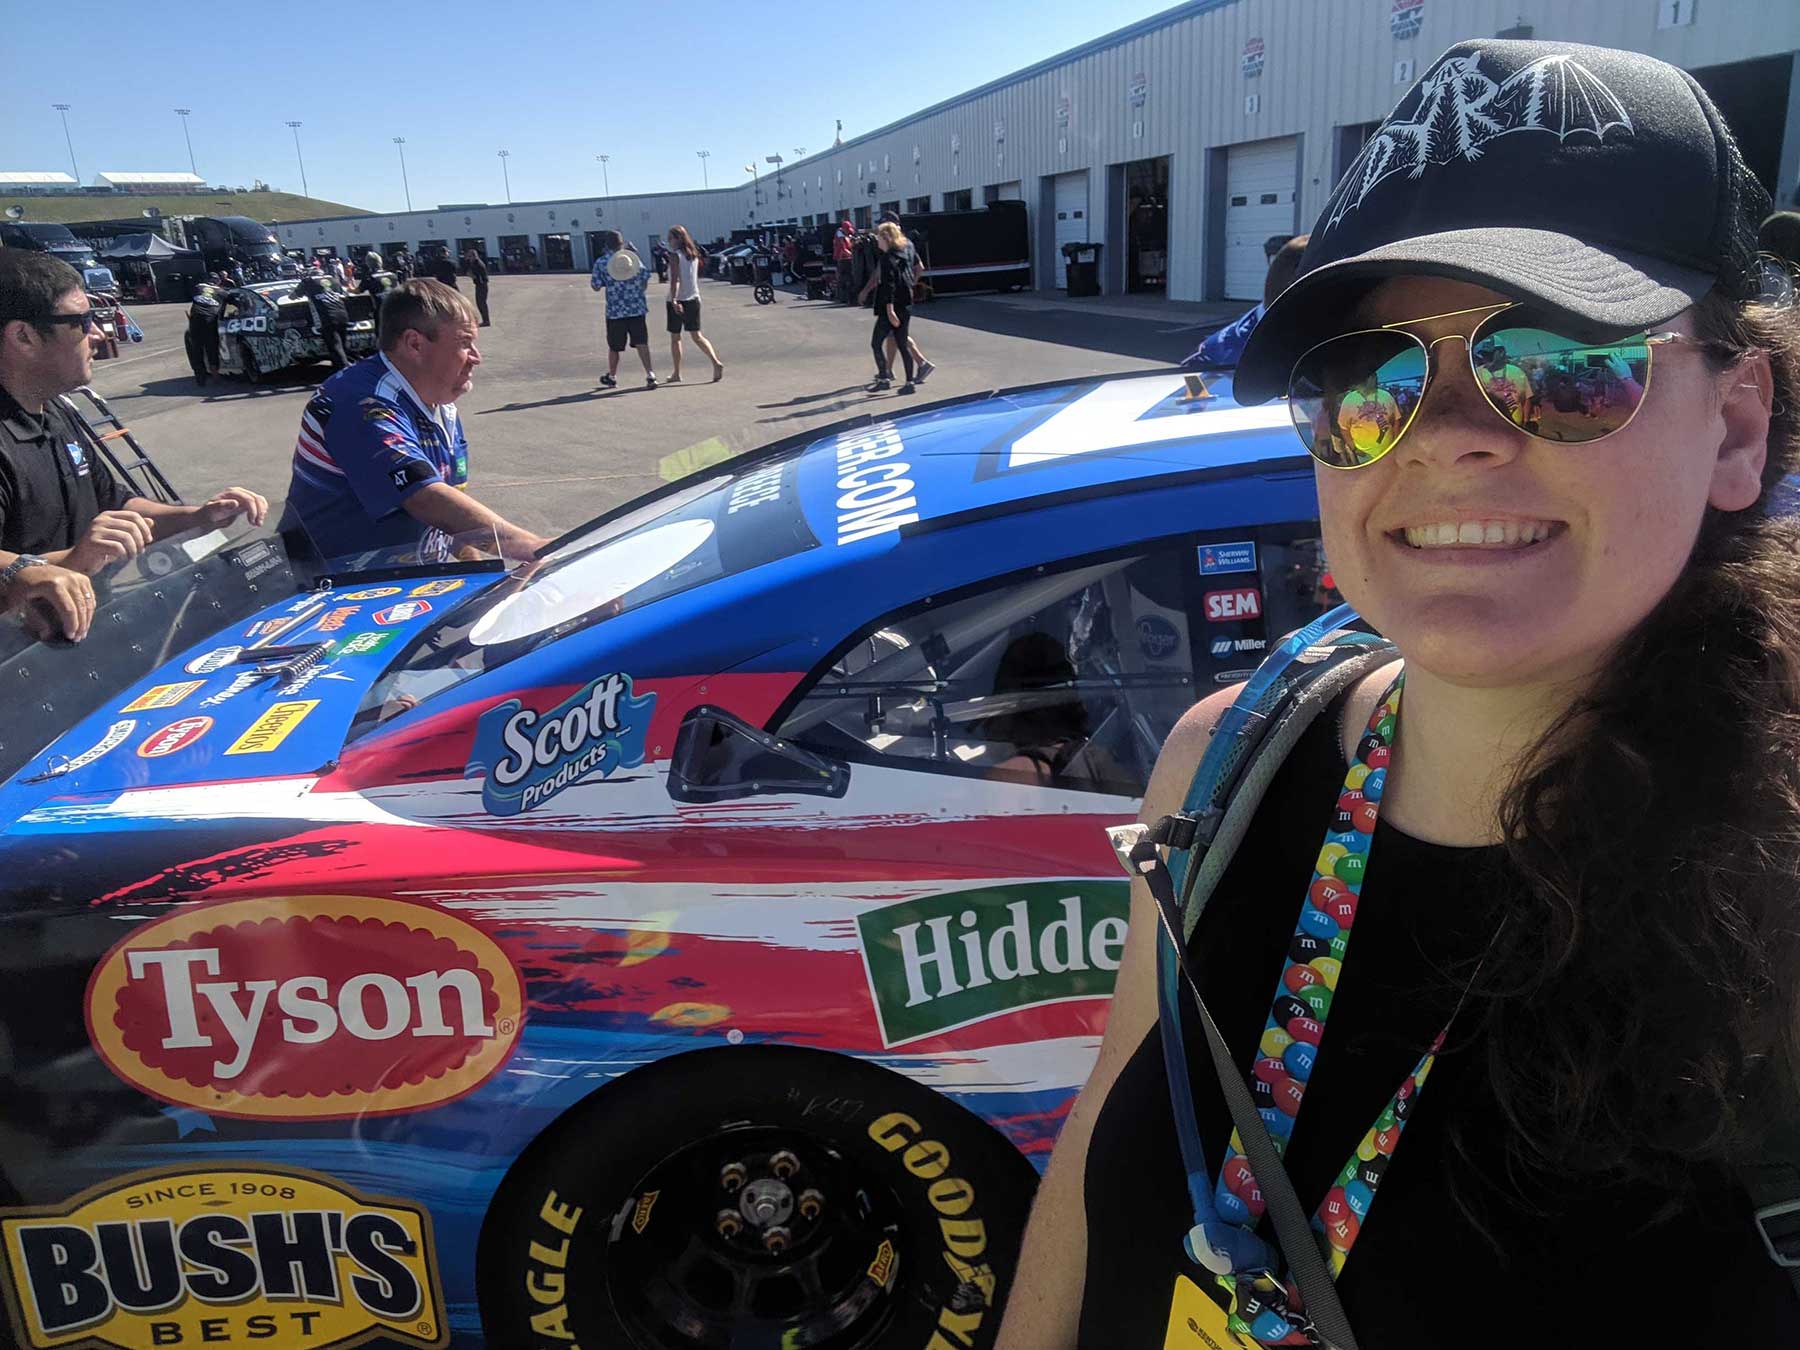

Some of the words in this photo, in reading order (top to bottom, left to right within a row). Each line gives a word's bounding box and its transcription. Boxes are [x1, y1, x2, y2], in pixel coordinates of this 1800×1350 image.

[1400, 63, 1407, 81] 2
[394, 470, 408, 487] 47
[1209, 592, 1258, 618] SEM
[1235, 639, 1267, 651] Miller
[1379, 709, 1387, 717] m
[238, 703, 307, 750] Cheerios
[494, 674, 624, 785] Scott
[1382, 725, 1390, 735] m
[148, 719, 207, 754] Tyson
[1370, 739, 1379, 748] m
[1378, 748, 1386, 757] m
[521, 742, 607, 812] Products
[1373, 778, 1382, 789] m
[1352, 791, 1363, 799] m
[1339, 810, 1350, 820] m
[1365, 807, 1376, 819] m
[1342, 834, 1354, 842] m
[1348, 858, 1361, 868] m
[1339, 903, 1351, 915] m
[1314, 911, 1329, 924] m
[1302, 938, 1316, 948] m
[1332, 938, 1345, 950] m
[892, 896, 1131, 1008] Hidde
[1300, 971, 1314, 982] m
[1309, 994, 1323, 1008] m
[127, 947, 498, 1080] Tyson
[1290, 1003, 1305, 1016] m
[1304, 1021, 1318, 1032] m
[1269, 1059, 1284, 1069] m
[1297, 1053, 1312, 1069] m
[1256, 1081, 1270, 1092] m
[1288, 1087, 1302, 1101] m
[1398, 1088, 1406, 1098] m
[1397, 1102, 1406, 1112] m
[1262, 1111, 1276, 1121] m
[1385, 1110, 1393, 1120] m
[1378, 1134, 1388, 1146] m
[1237, 1167, 1251, 1179] m
[1346, 1167, 1356, 1179] m
[1366, 1170, 1378, 1184] m
[127, 1183, 216, 1209] SINCE
[229, 1181, 297, 1200] 1908
[1226, 1198, 1240, 1210] m
[1329, 1202, 1341, 1214] m
[1349, 1196, 1362, 1210] m
[1335, 1225, 1348, 1238] m
[18, 1210, 423, 1334] BUSH'S
[526, 1190, 584, 1350] AGLE
[1246, 1299, 1260, 1313] m
[152, 1311, 322, 1346] BEST
[1237, 1323, 1250, 1334] m
[1268, 1325, 1284, 1338] m
